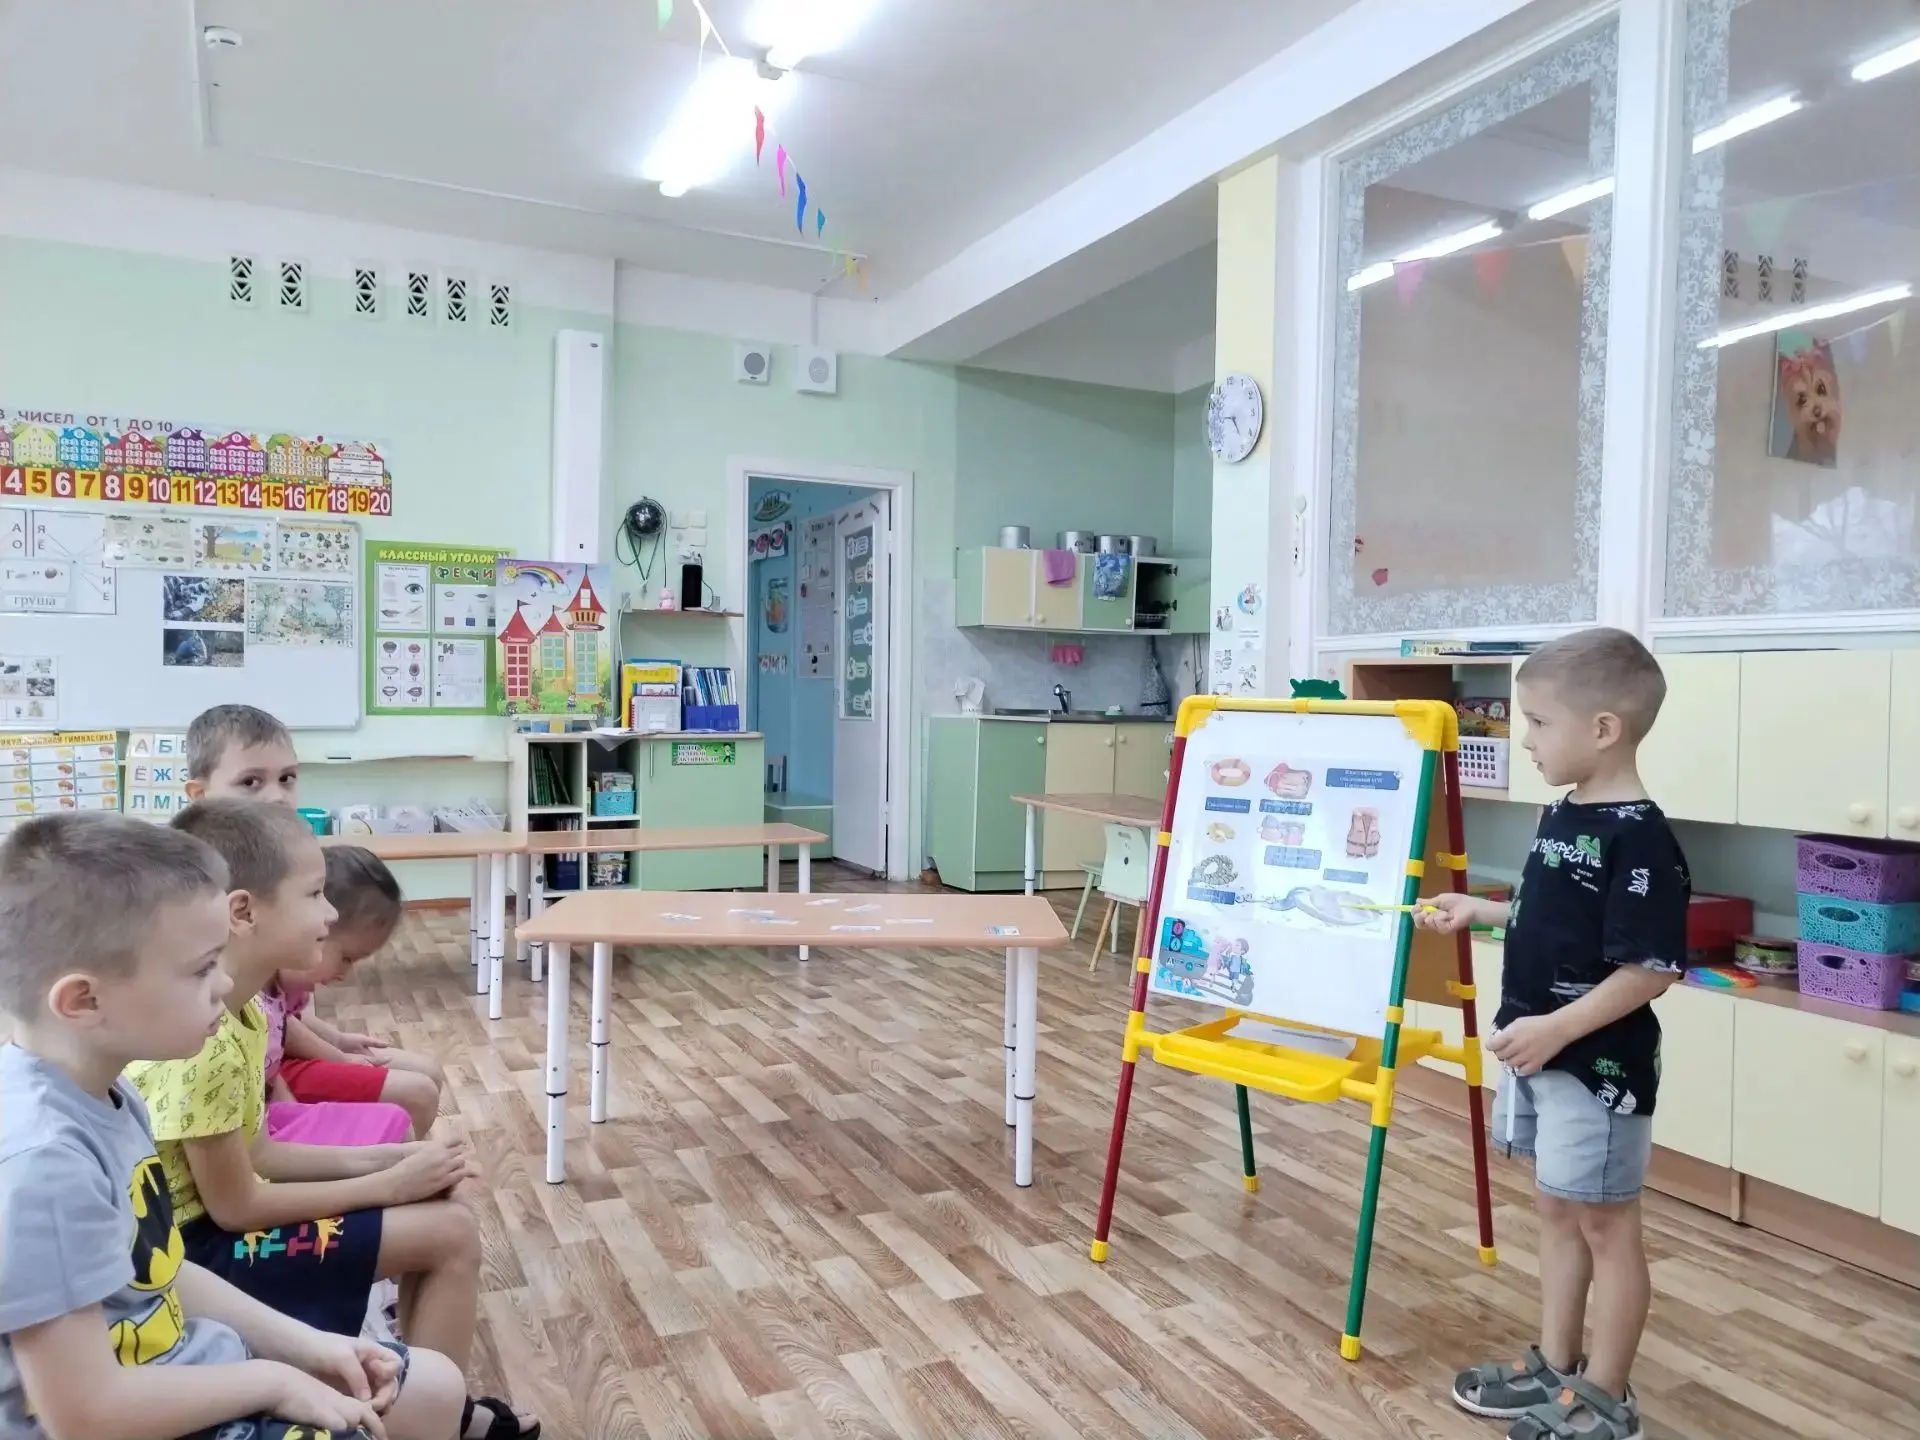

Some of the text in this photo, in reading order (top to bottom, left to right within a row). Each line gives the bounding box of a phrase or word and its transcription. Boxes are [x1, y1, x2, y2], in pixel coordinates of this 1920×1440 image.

[18, 410, 75, 425] ЧИСЕЛ
[86, 415, 108, 427] ОТ
[113, 418, 119, 428] 1
[128, 419, 153, 432] ДО
[157, 421, 173, 433] 10
[5, 468, 391, 514] 4 5 6 7 8 9 10 11 12 13 14 15 16 17 18 19 20
[379, 549, 495, 564] КЛАССНЫЙ УГОЛОК
[436, 565, 494, 583] РЕЧИ
[14, 596, 56, 608] груша
[64, 733, 114, 744] ГИМНАСТИКА
[134, 738, 150, 754] А
[158, 739, 173, 754] Б
[134, 764, 148, 782] Ё
[153, 767, 172, 782] Ж
[131, 794, 146, 809] Л
[153, 795, 171, 810] М
